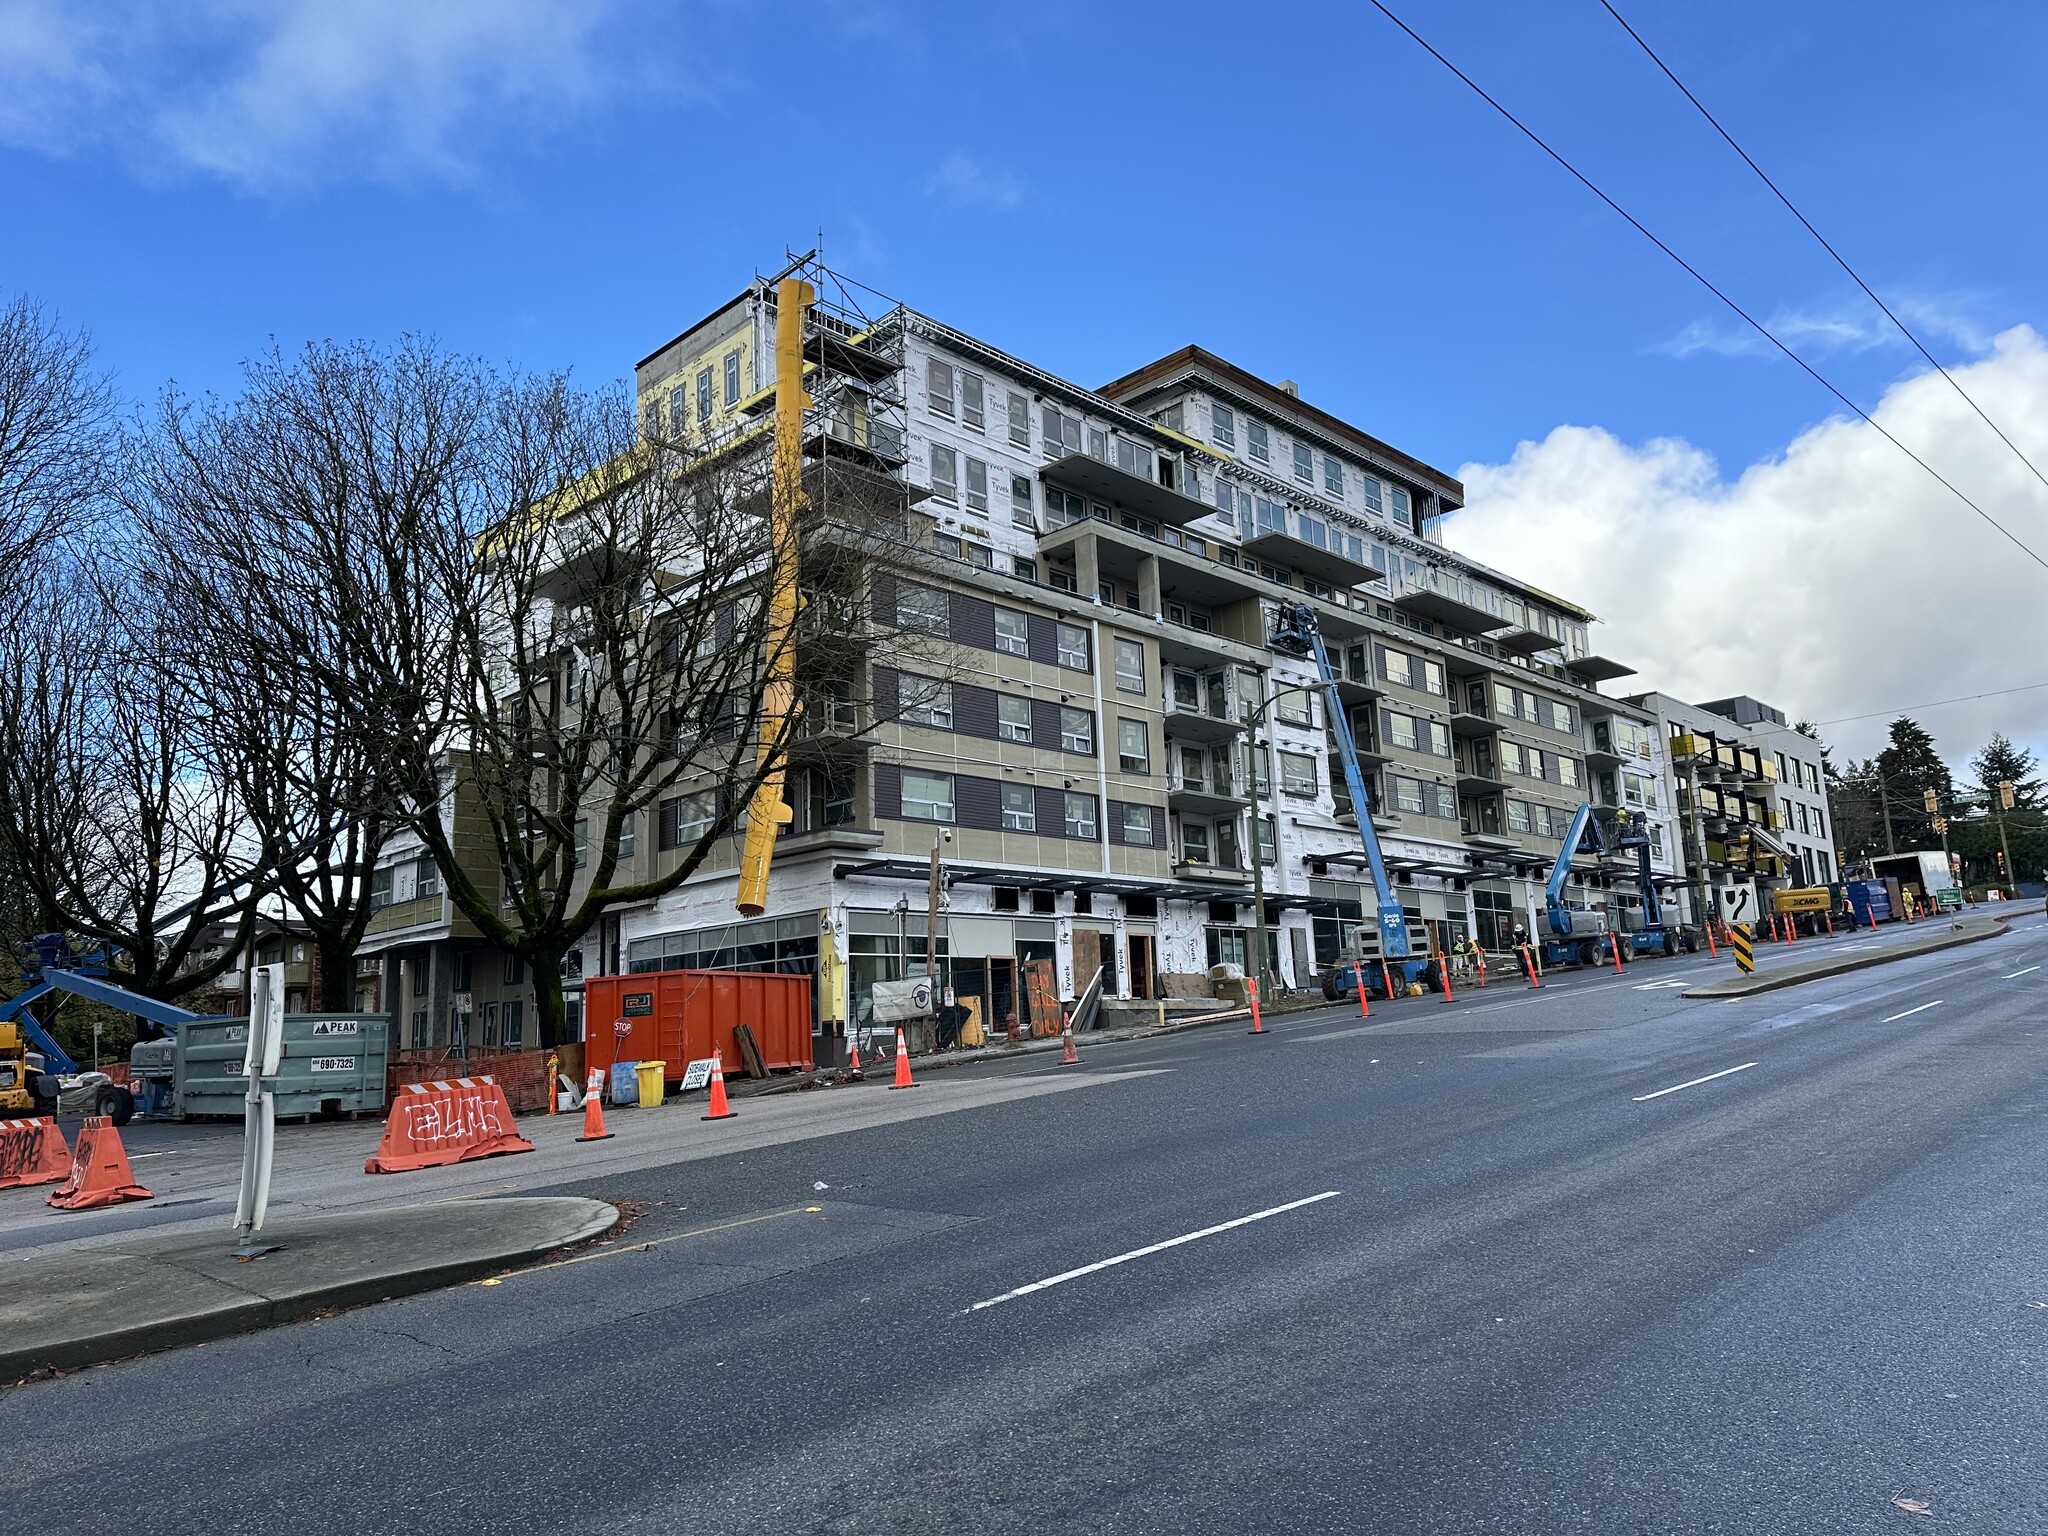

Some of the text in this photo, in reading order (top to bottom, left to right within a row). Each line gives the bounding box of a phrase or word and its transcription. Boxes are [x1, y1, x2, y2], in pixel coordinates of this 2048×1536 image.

[988, 397, 1007, 411] Tyvek
[991, 481, 1010, 494] Tyvek
[1289, 869, 1302, 878] Tyvek
[1188, 938, 1197, 963] Tyvek
[1117, 948, 1125, 974] Tyvek
[330, 1022, 356, 1032] PEAK
[614, 1022, 632, 1032] STOP
[688, 1061, 711, 1075] SIDEWALK
[685, 1073, 705, 1086] CLOSED
